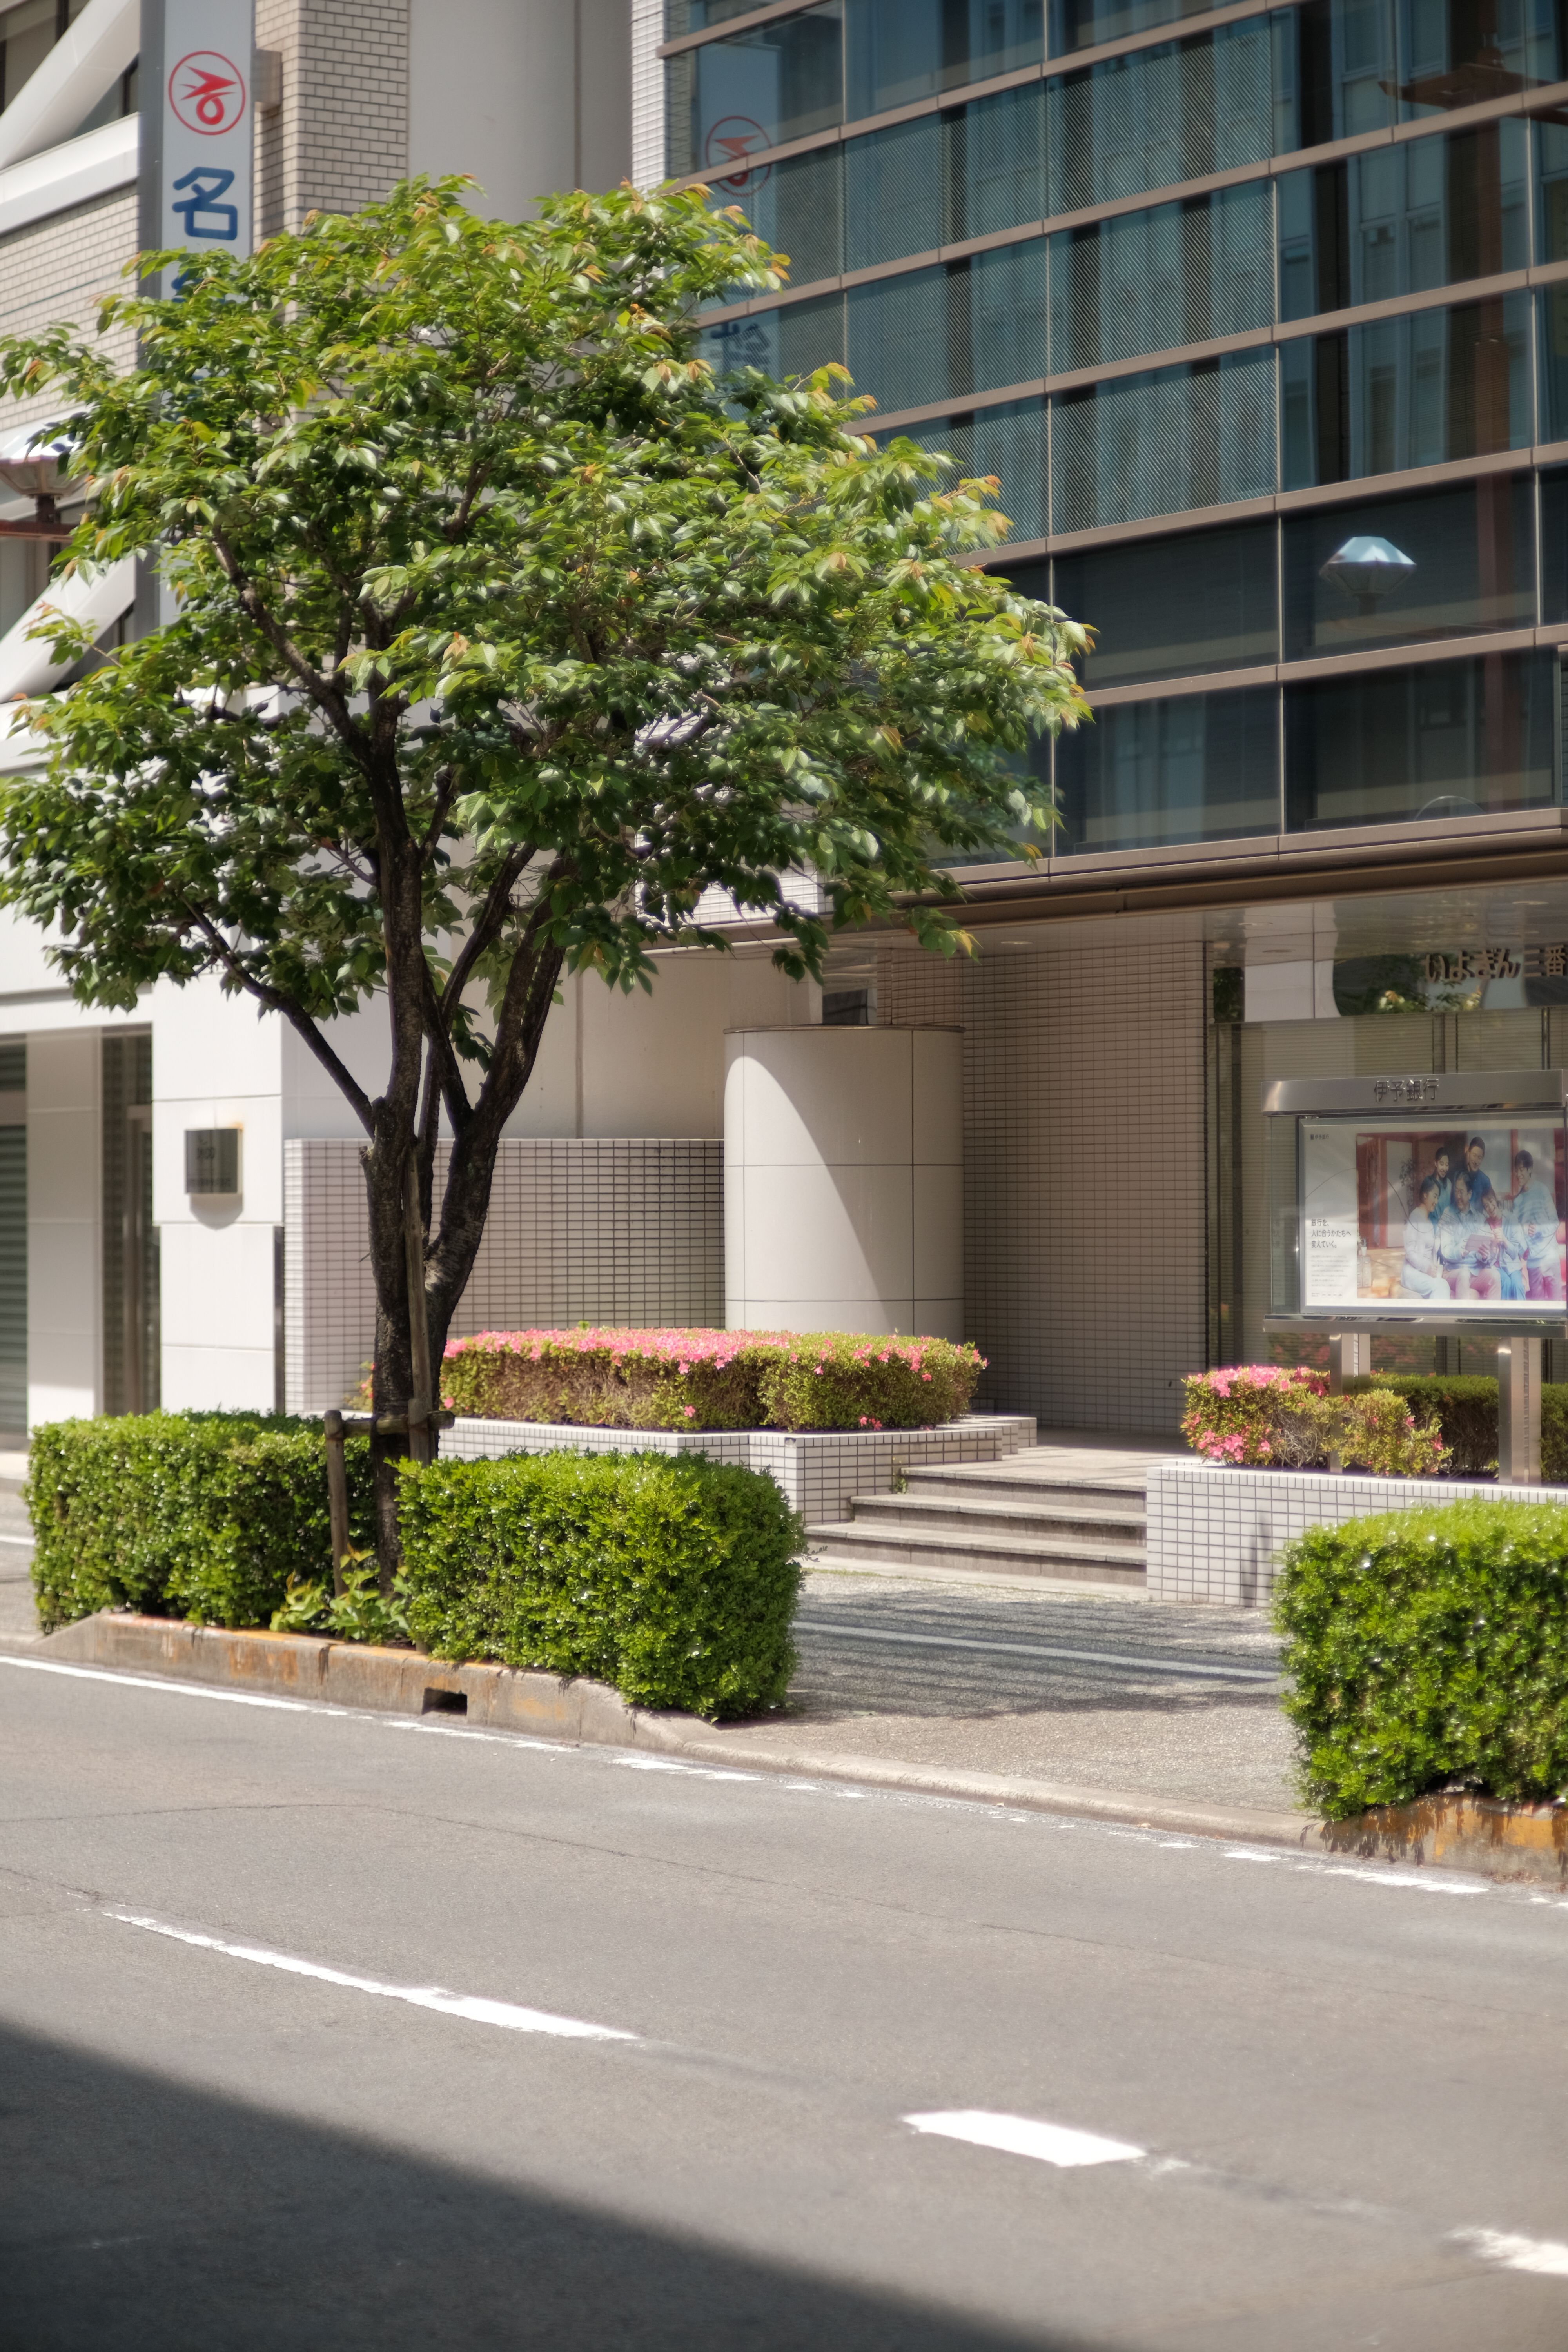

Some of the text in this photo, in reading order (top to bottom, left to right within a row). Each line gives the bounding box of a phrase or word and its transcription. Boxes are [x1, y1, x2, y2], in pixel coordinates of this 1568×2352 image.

[1424, 944, 1565, 982] いよぎん三番
[1374, 1079, 1439, 1102] 伊予銀行
